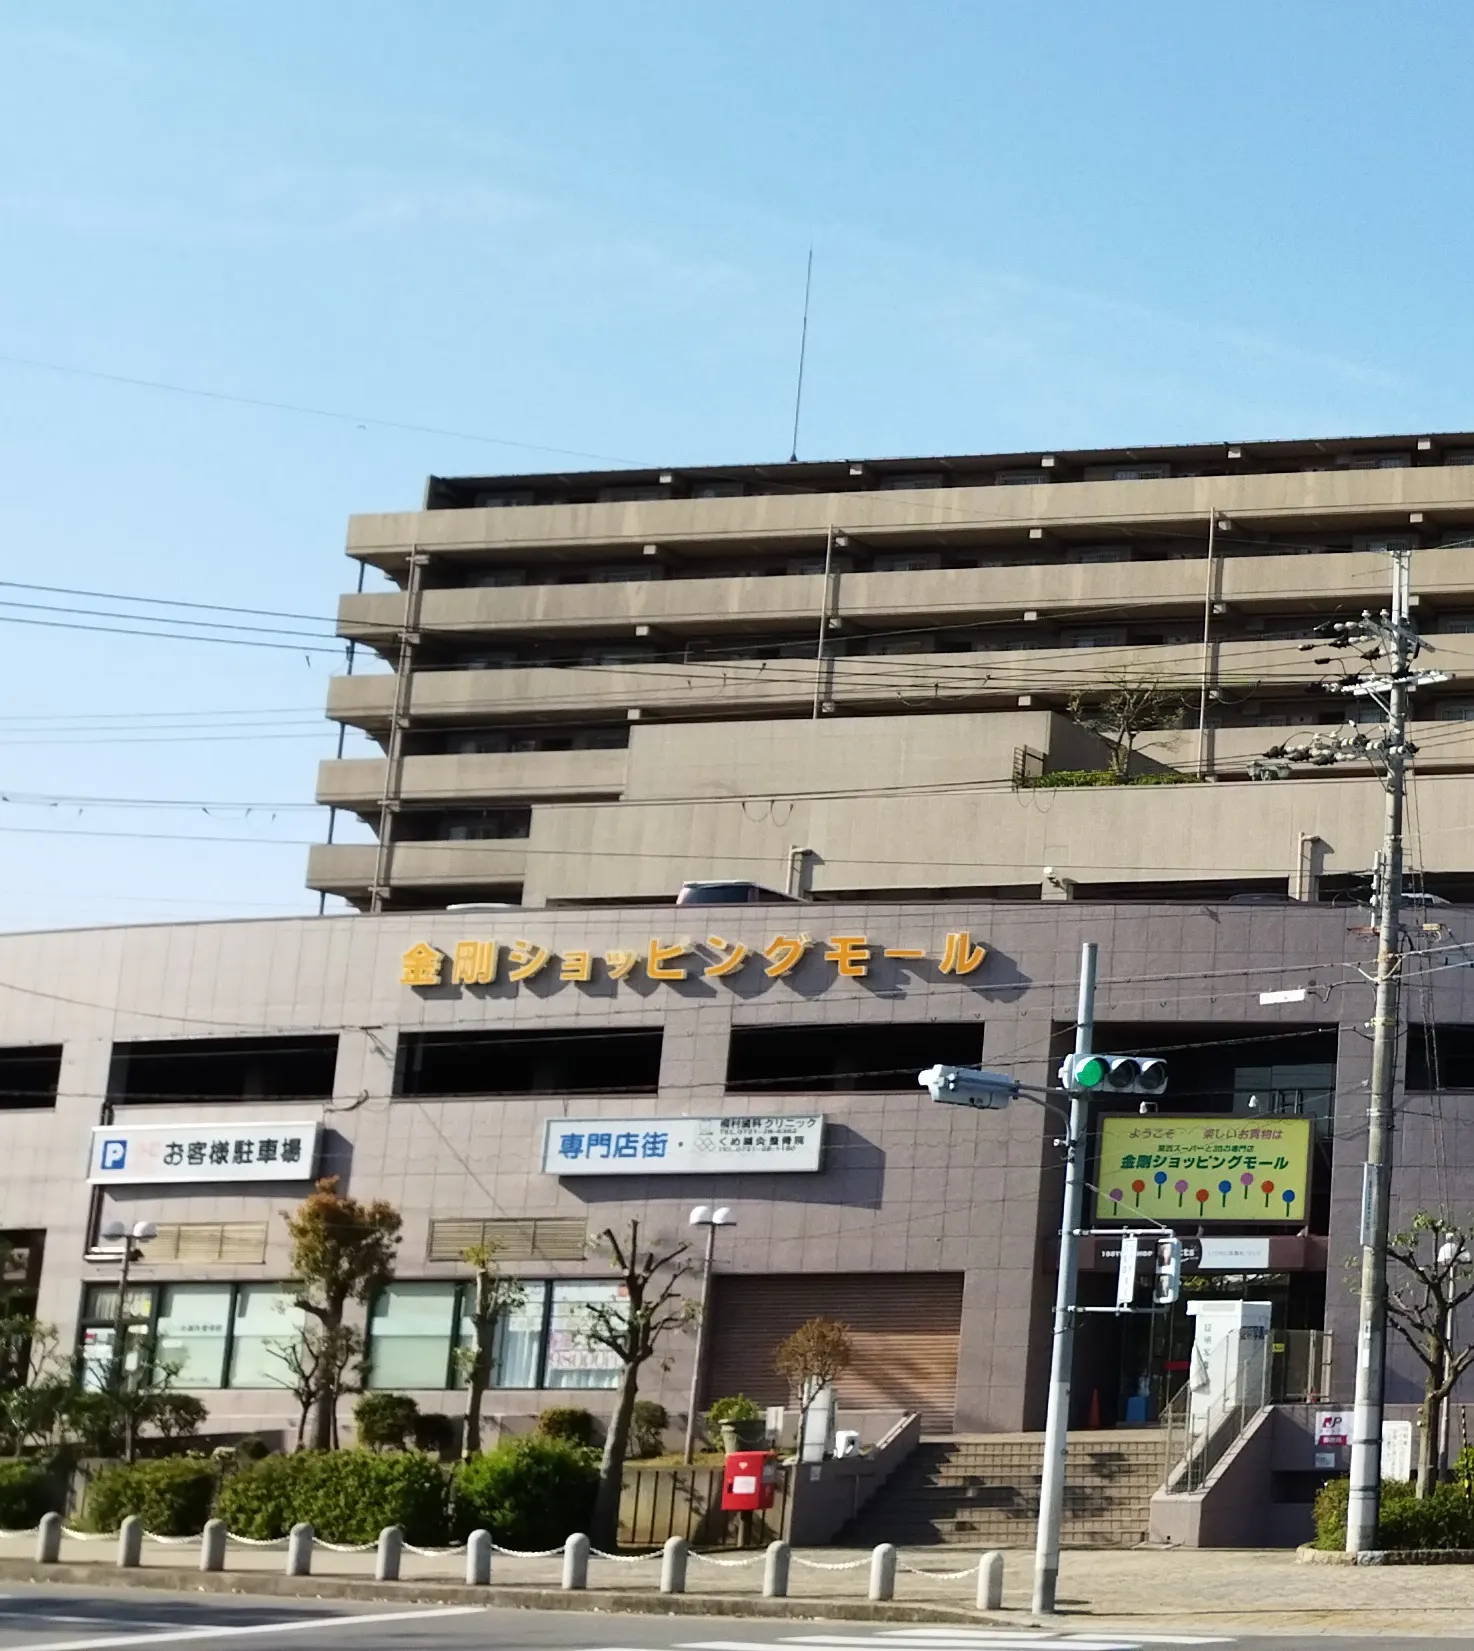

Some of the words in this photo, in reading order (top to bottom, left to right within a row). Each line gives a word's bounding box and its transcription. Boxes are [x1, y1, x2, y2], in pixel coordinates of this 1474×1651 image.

[399, 931, 986, 986] 金剛ショッピングモール
[1129, 1128, 1176, 1140] ようこそ
[163, 1138, 302, 1165] お客様駐車場
[1120, 1154, 1289, 1170] 金剛ショッピングモール
